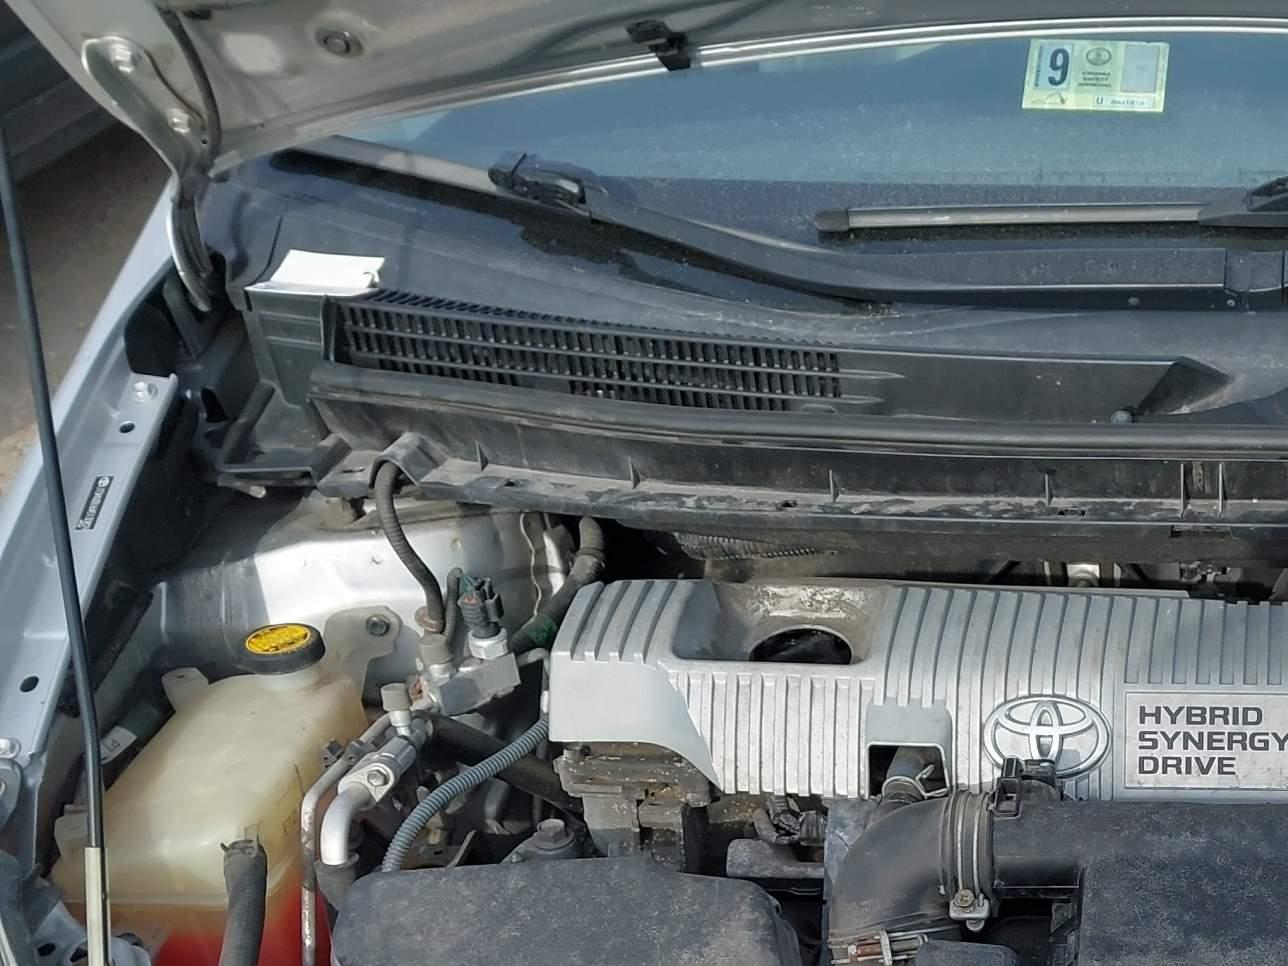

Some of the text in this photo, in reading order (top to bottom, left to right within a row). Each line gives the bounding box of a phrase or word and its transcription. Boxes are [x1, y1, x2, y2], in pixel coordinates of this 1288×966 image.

[1047, 47, 1070, 86] 9
[1138, 705, 1263, 726] HYBRID
[1138, 756, 1236, 775] DRIVE
